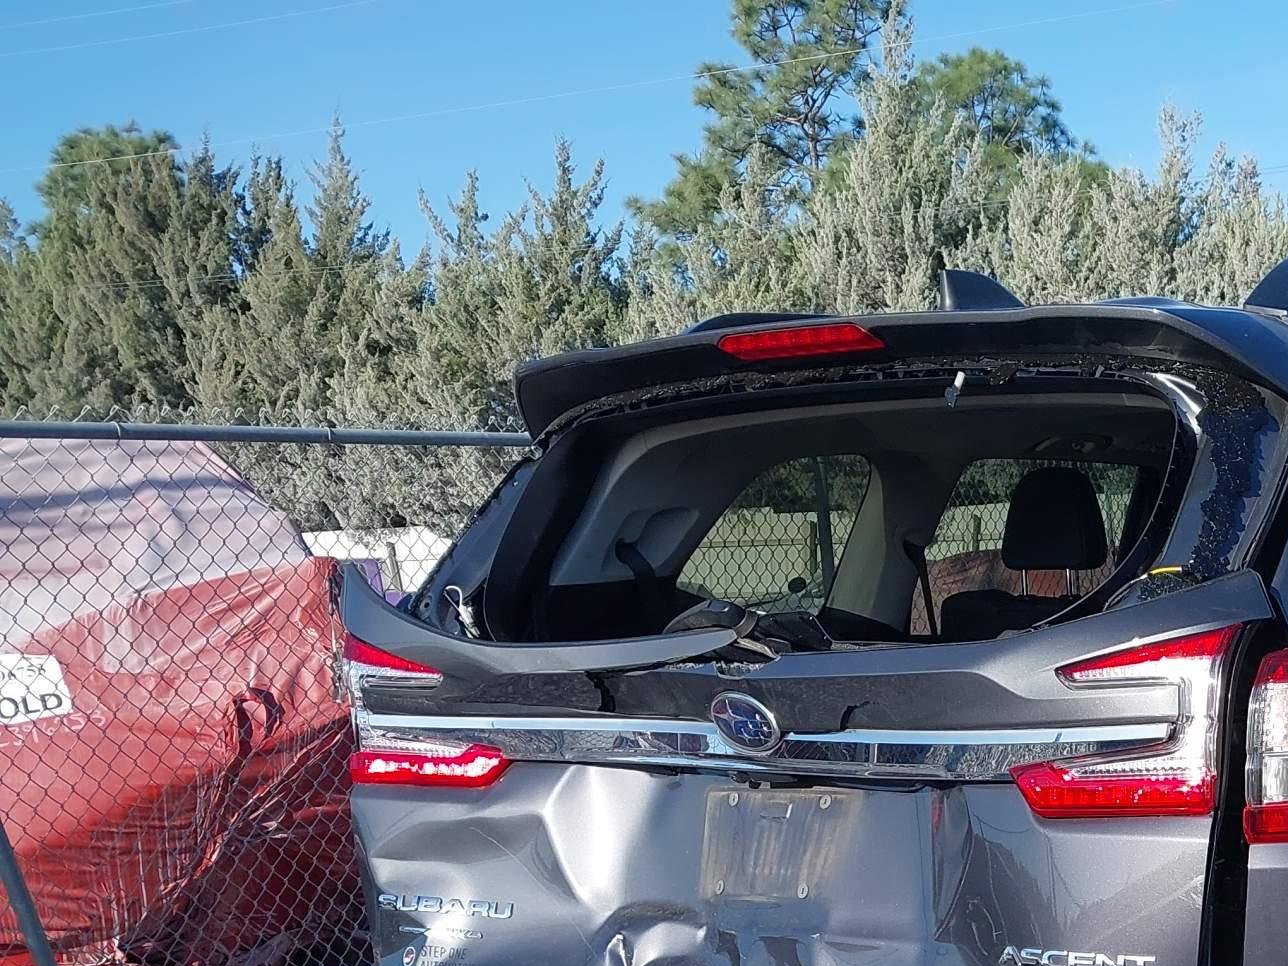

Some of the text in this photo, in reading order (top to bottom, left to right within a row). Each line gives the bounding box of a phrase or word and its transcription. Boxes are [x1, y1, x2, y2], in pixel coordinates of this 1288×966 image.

[377, 893, 515, 919] SUBARU
[419, 944, 468, 961] STEP ONE
